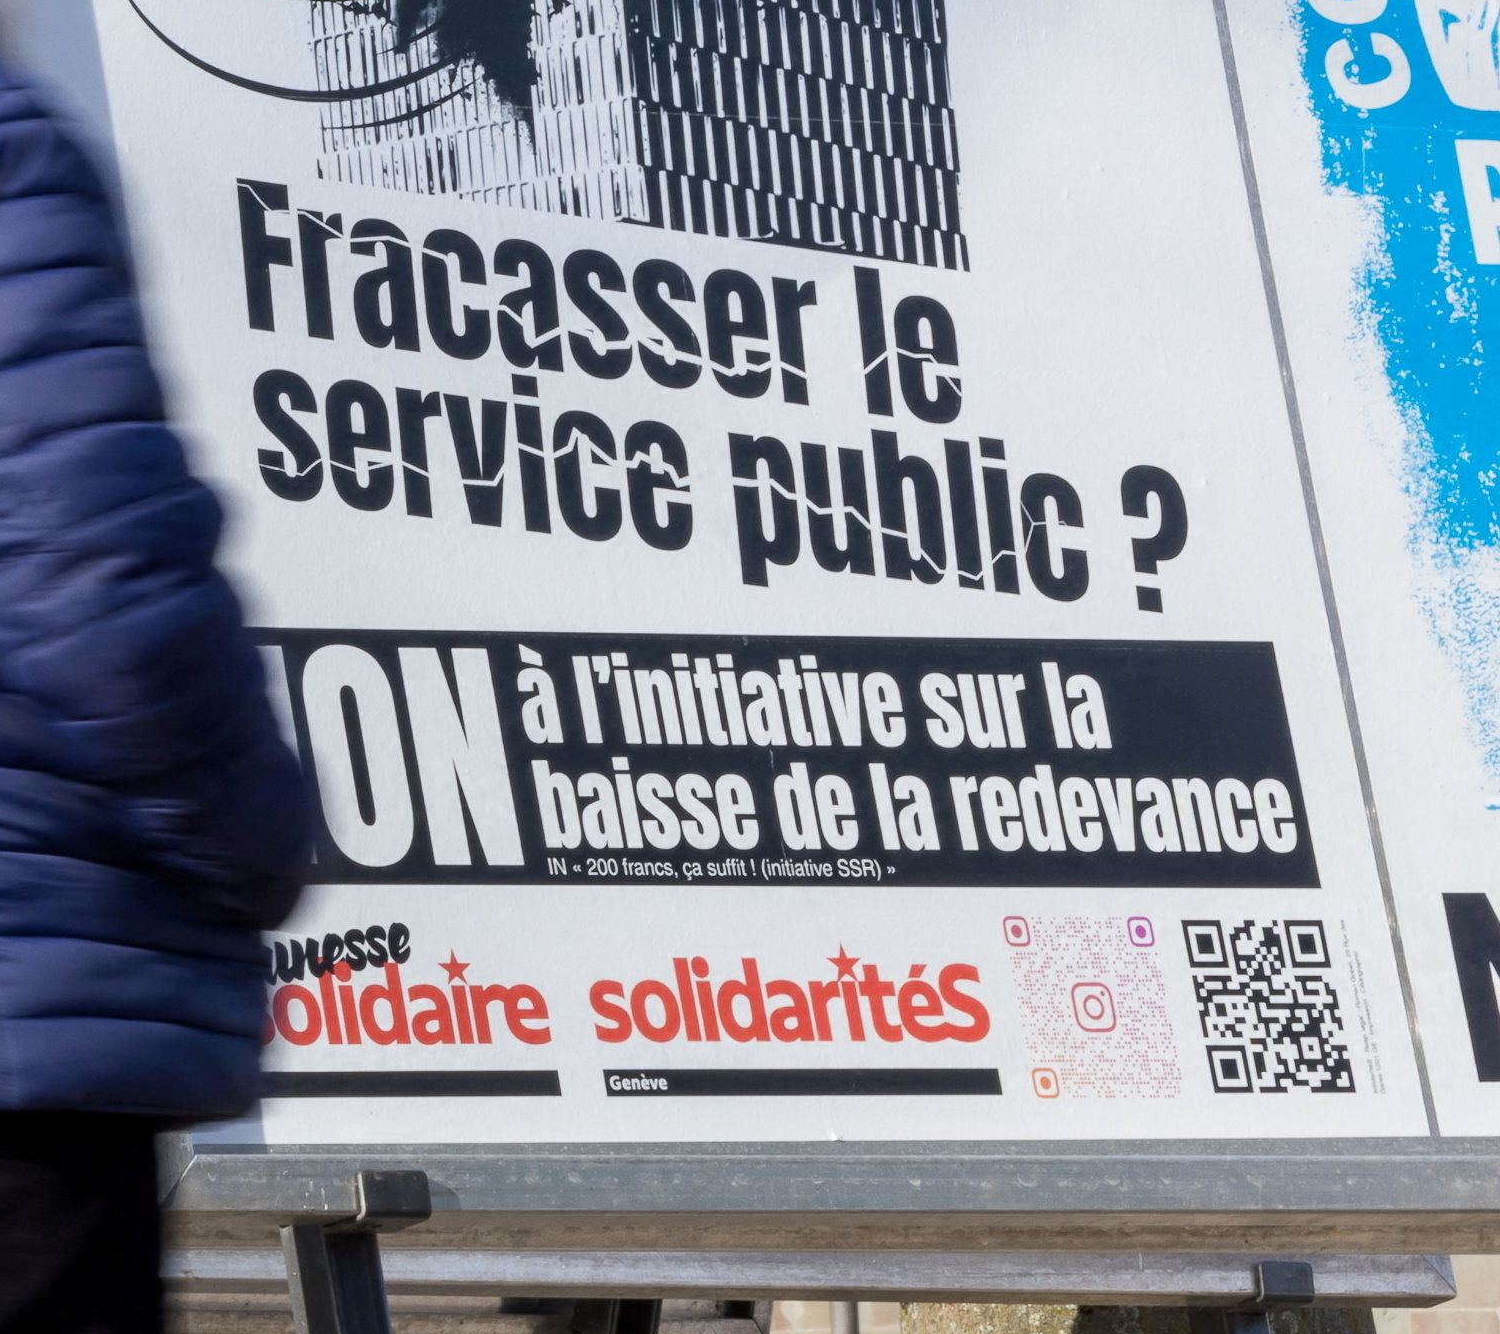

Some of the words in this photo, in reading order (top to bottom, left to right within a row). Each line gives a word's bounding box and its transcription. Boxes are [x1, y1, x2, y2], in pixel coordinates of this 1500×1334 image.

[236, 177, 816, 406] Fracasser
[853, 265, 963, 426] le
[252, 368, 694, 553] service
[728, 428, 1090, 603] public
[1120, 462, 1188, 613] ?
[517, 644, 563, 745] à
[573, 652, 906, 747] l'initiative
[919, 672, 1026, 749] sur
[1041, 662, 1112, 749] la
[531, 757, 760, 851] baisse
[773, 763, 859, 851] de
[868, 763, 941, 852] la
[949, 764, 1298, 854] redevance
[547, 858, 568, 876] IN
[586, 858, 619, 876] 200
[622, 859, 679, 879] francs,
[683, 863, 703, 881] ça
[706, 859, 749, 877] suffit
[761, 859, 833, 880] (initiative
[838, 860, 882, 880] SSR)
[263, 923, 410, 985] unesse
[609, 1073, 668, 1092] Genève
